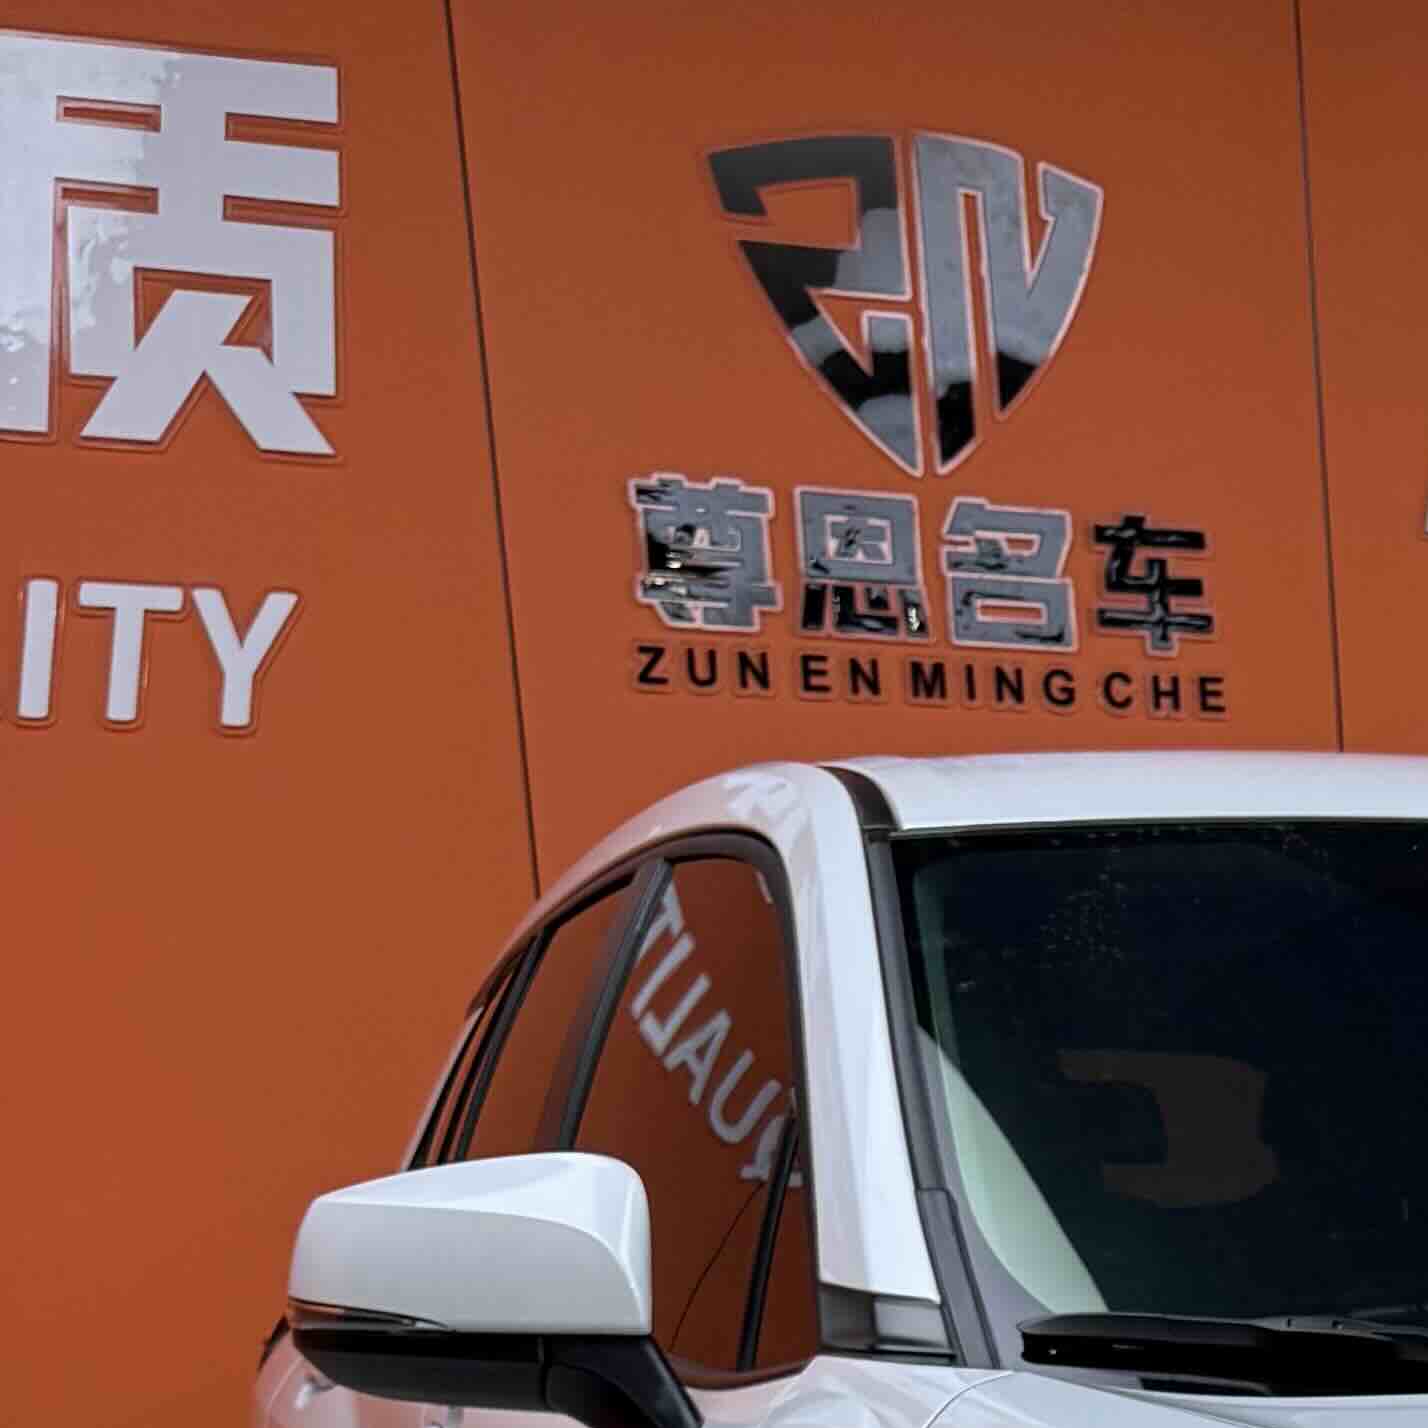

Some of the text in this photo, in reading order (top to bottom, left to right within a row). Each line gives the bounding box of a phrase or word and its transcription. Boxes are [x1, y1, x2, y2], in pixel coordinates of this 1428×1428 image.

[627, 472, 1217, 656] 尊恩名车
[17, 578, 299, 728] ITY
